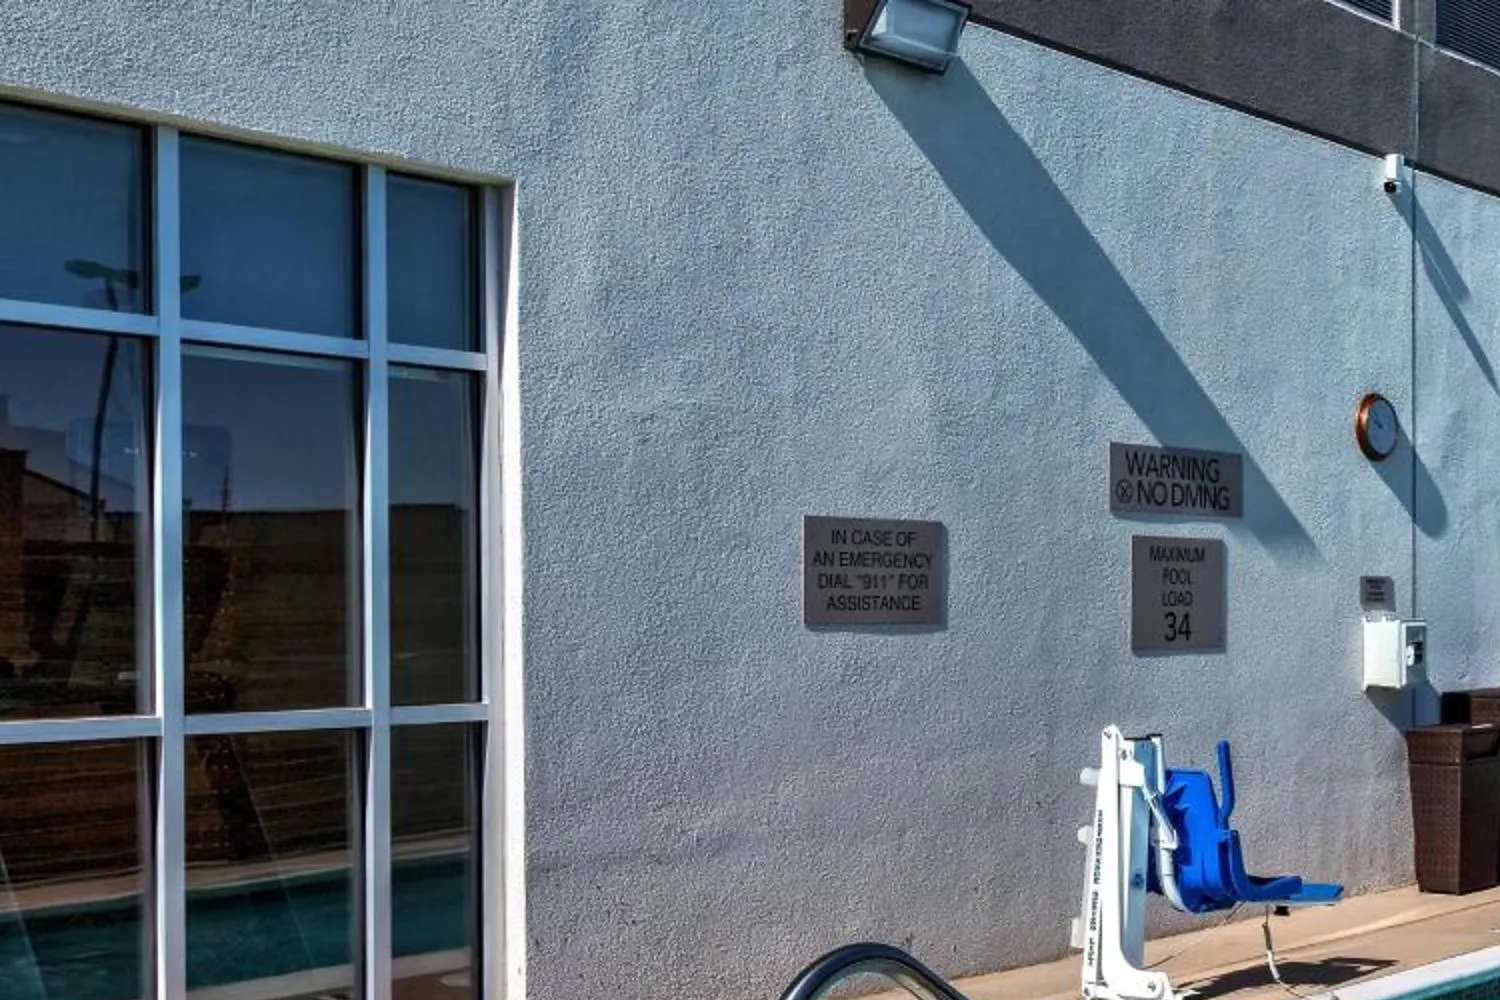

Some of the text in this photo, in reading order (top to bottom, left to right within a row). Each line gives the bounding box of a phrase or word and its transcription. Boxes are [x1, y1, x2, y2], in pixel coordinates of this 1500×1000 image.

[1125, 449, 1220, 483] WARNING
[1137, 480, 1230, 510] NO DIVING
[831, 529, 917, 548] IN CASE OF
[813, 551, 931, 569] AN EMERGENCY
[1150, 545, 1205, 562] MAXIMUM
[818, 573, 852, 589] DIAL
[899, 574, 929, 591] FOR
[826, 594, 921, 611] ASSISTANCE
[1162, 590, 1193, 607] LOAD
[1165, 611, 1192, 642] 34
